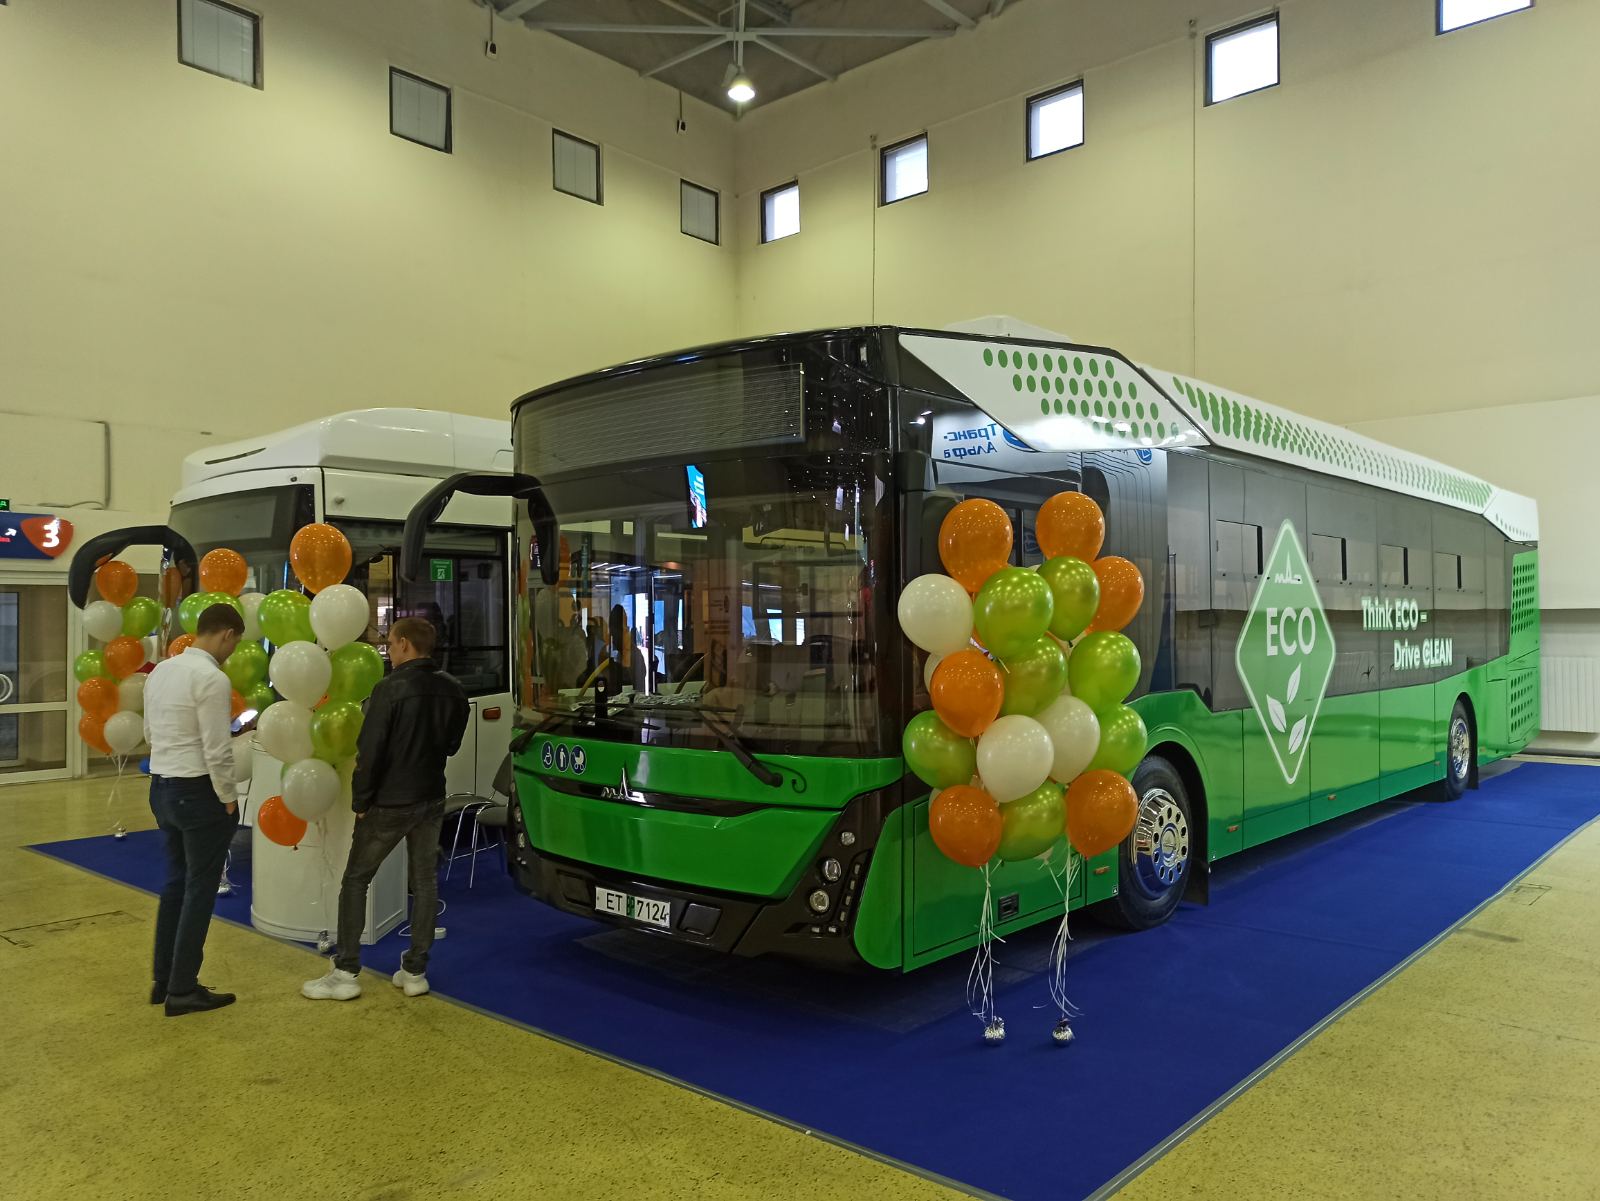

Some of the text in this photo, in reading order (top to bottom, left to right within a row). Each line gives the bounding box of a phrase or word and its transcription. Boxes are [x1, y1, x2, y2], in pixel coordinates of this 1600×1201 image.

[42, 518, 60, 548] 3
[1361, 596, 1393, 631] Think
[1395, 598, 1419, 631] ECO
[1266, 606, 1316, 657] ECO
[1393, 637, 1453, 671] Drive CLEAN
[637, 900, 669, 923] 7124
